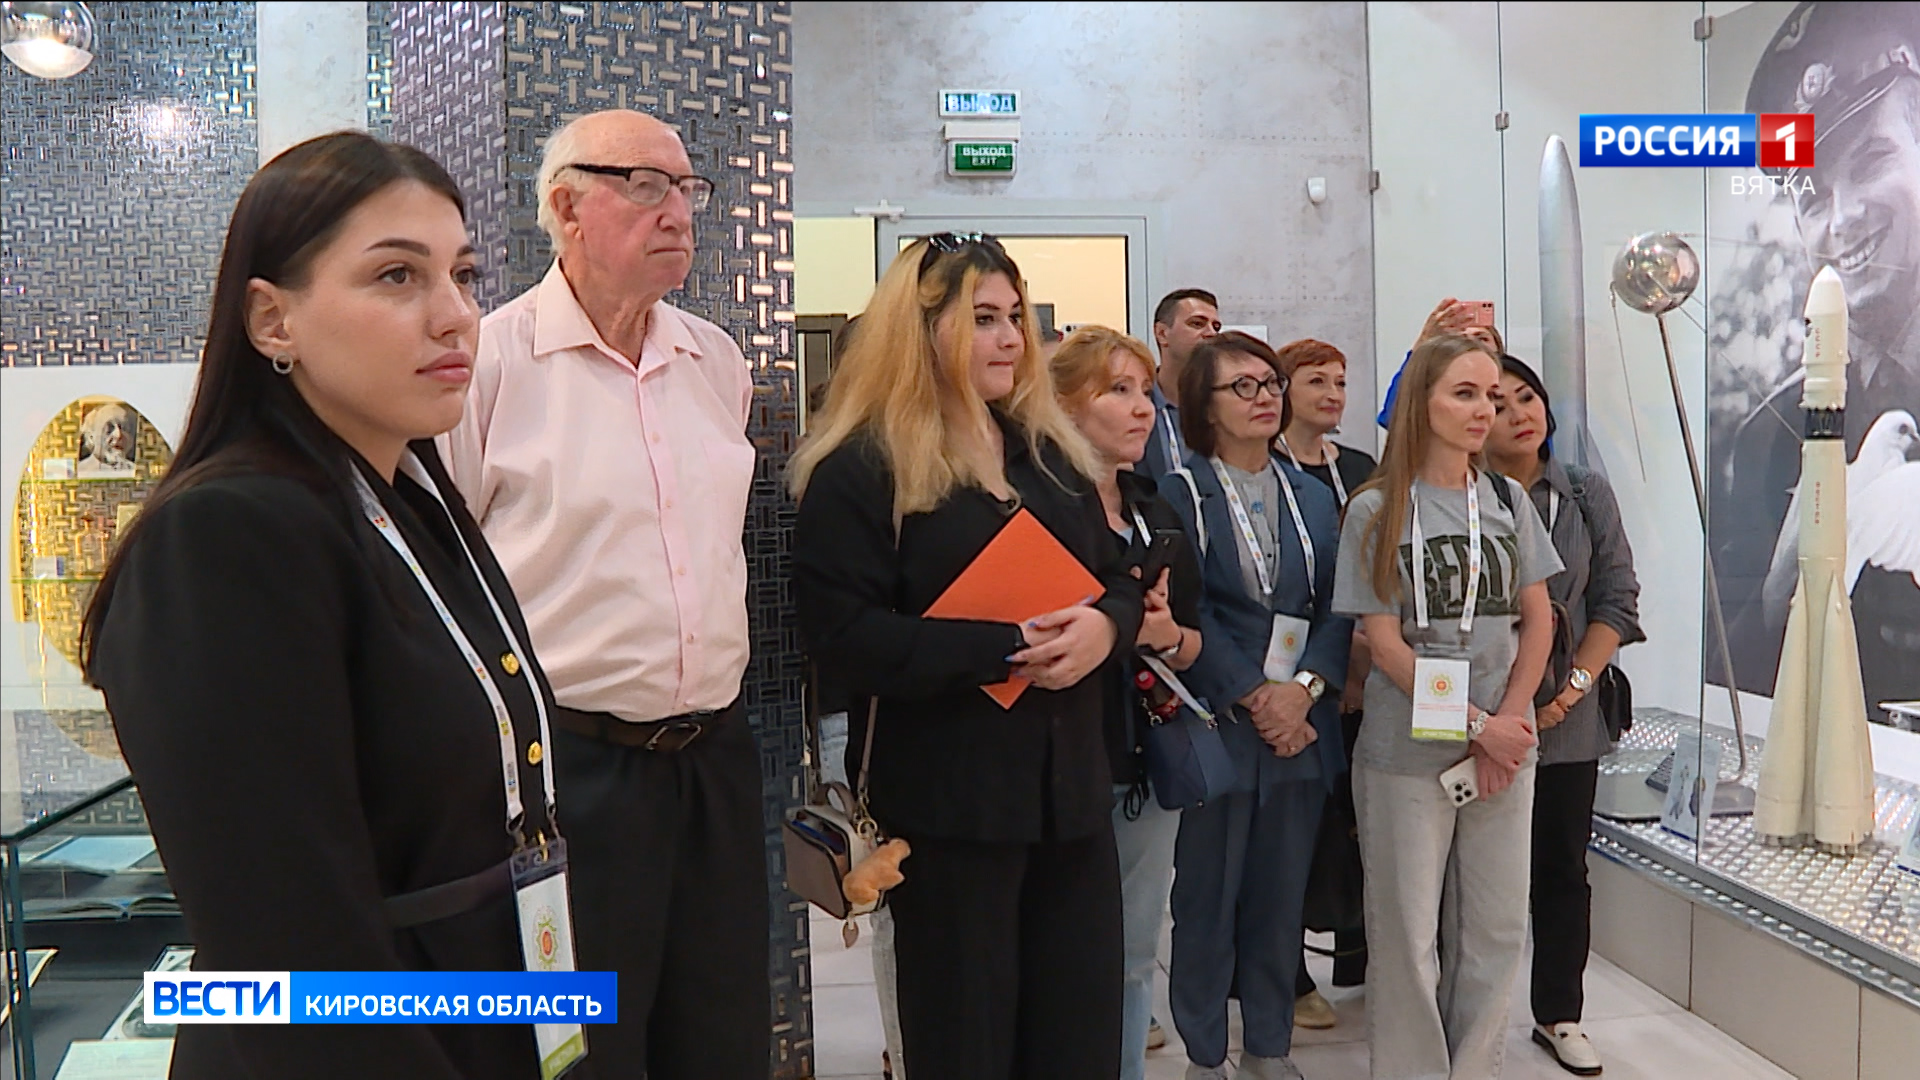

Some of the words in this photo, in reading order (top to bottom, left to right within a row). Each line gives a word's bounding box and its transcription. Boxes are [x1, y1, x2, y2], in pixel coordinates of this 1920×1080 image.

[947, 94, 1013, 111] ВЫОД
[963, 147, 1006, 157] ВЫХОД
[972, 157, 997, 166] EXIT
